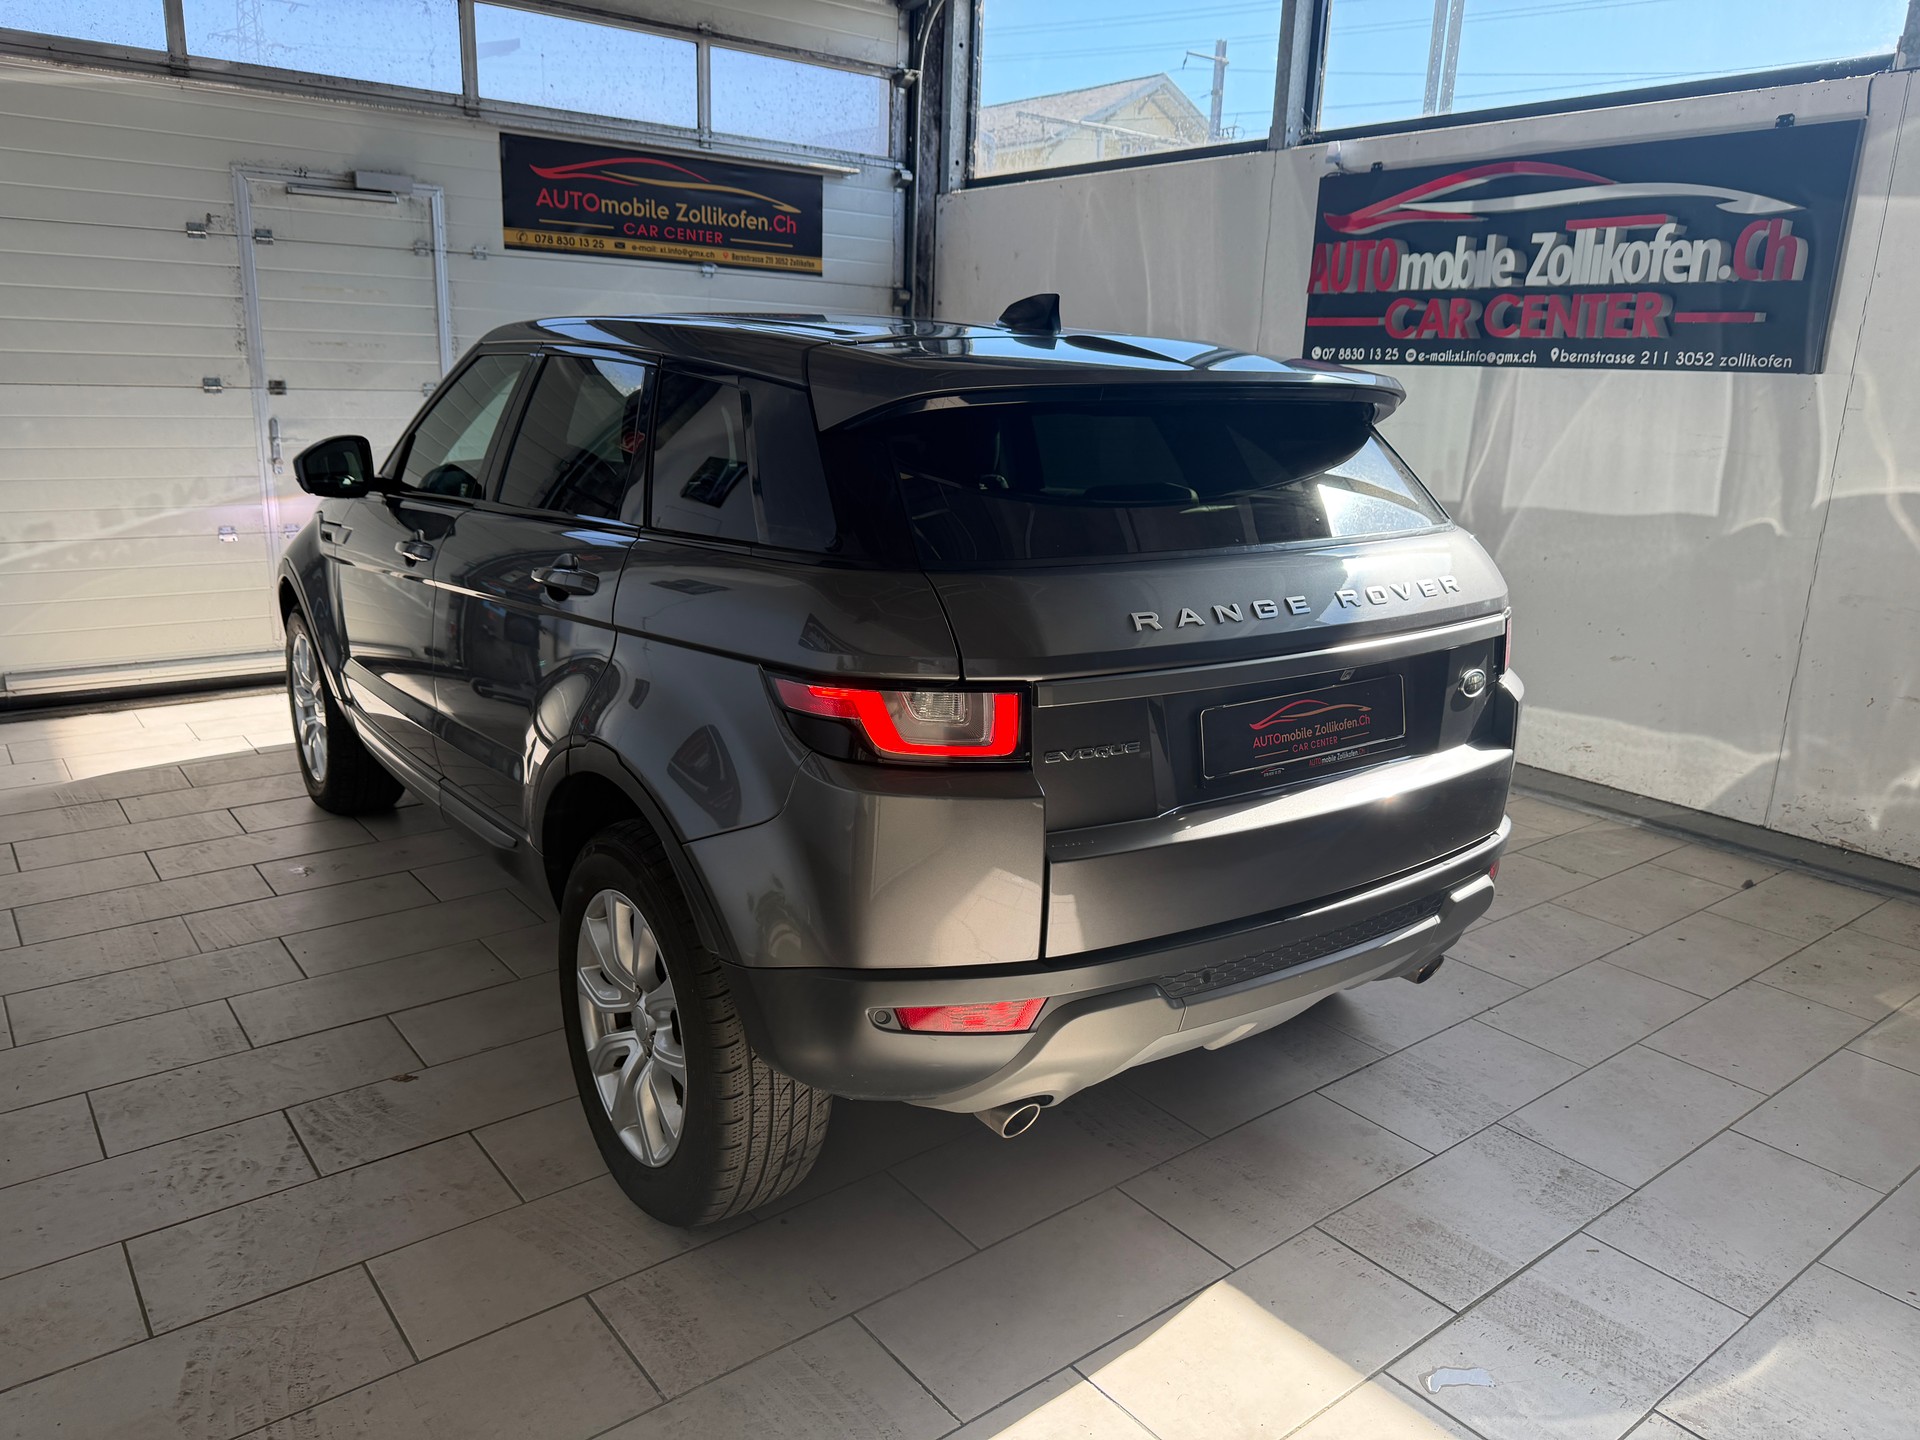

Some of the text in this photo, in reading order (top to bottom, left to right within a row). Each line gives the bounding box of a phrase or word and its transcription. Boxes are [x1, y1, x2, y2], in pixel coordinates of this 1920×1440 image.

[536, 187, 797, 235] AUTOmobile Zollikofen.Ch
[534, 233, 605, 249] 078 830 13 25
[623, 222, 723, 244] CAR CENTER
[1307, 217, 1806, 293] AUTOmobile Zollikofen.Ch
[1384, 292, 1668, 339] CAR CENTER
[1322, 347, 1399, 361] 07 8830 13 25
[1559, 348, 1793, 369] bernstrasse 211 3052 zollikofen
[1130, 575, 1461, 632] RANGE ROVER
[1253, 714, 1371, 748] AUTOmobile Zollikofen.Ch
[1044, 741, 1140, 764] EVOQUE
[1292, 735, 1338, 753] CAR CENTER
